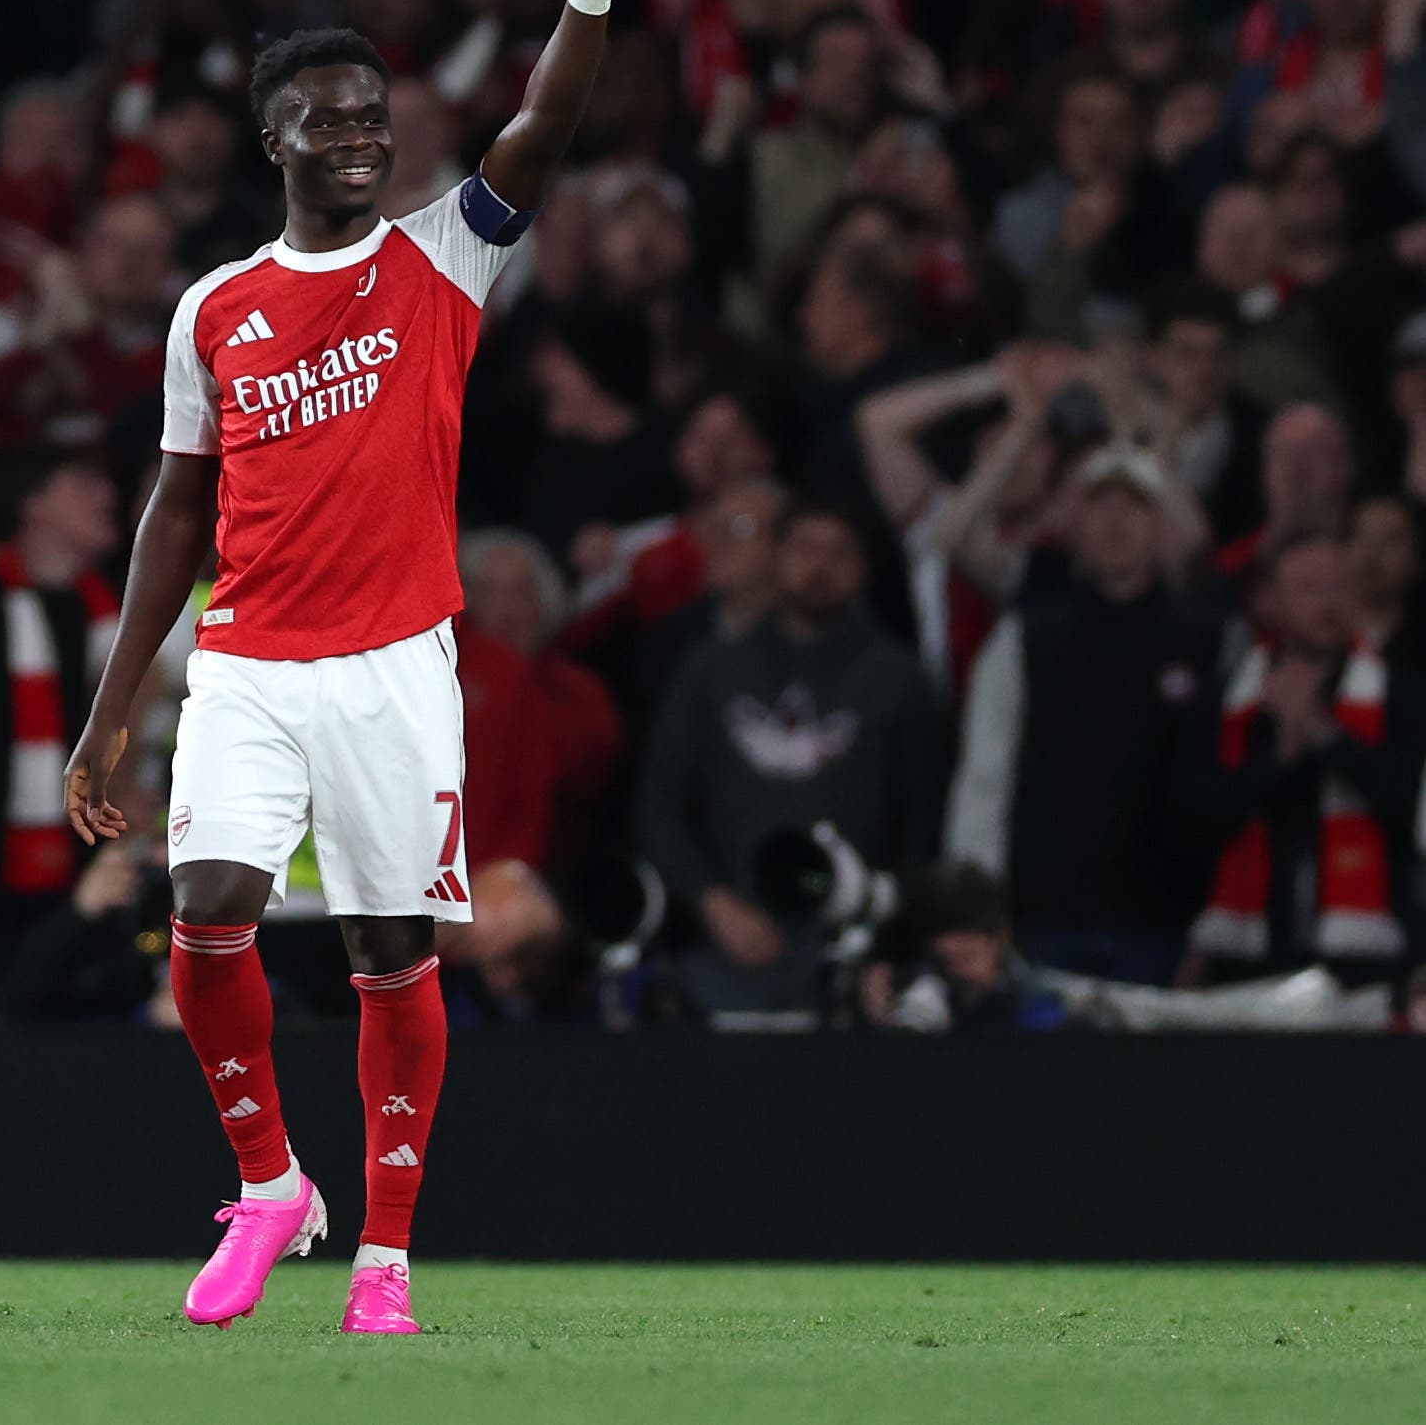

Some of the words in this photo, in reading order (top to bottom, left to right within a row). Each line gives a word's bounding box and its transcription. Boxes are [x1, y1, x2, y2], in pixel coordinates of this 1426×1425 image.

[232, 327, 399, 415] Emirates
[300, 372, 380, 428] BETTER
[434, 790, 461, 867] 7
